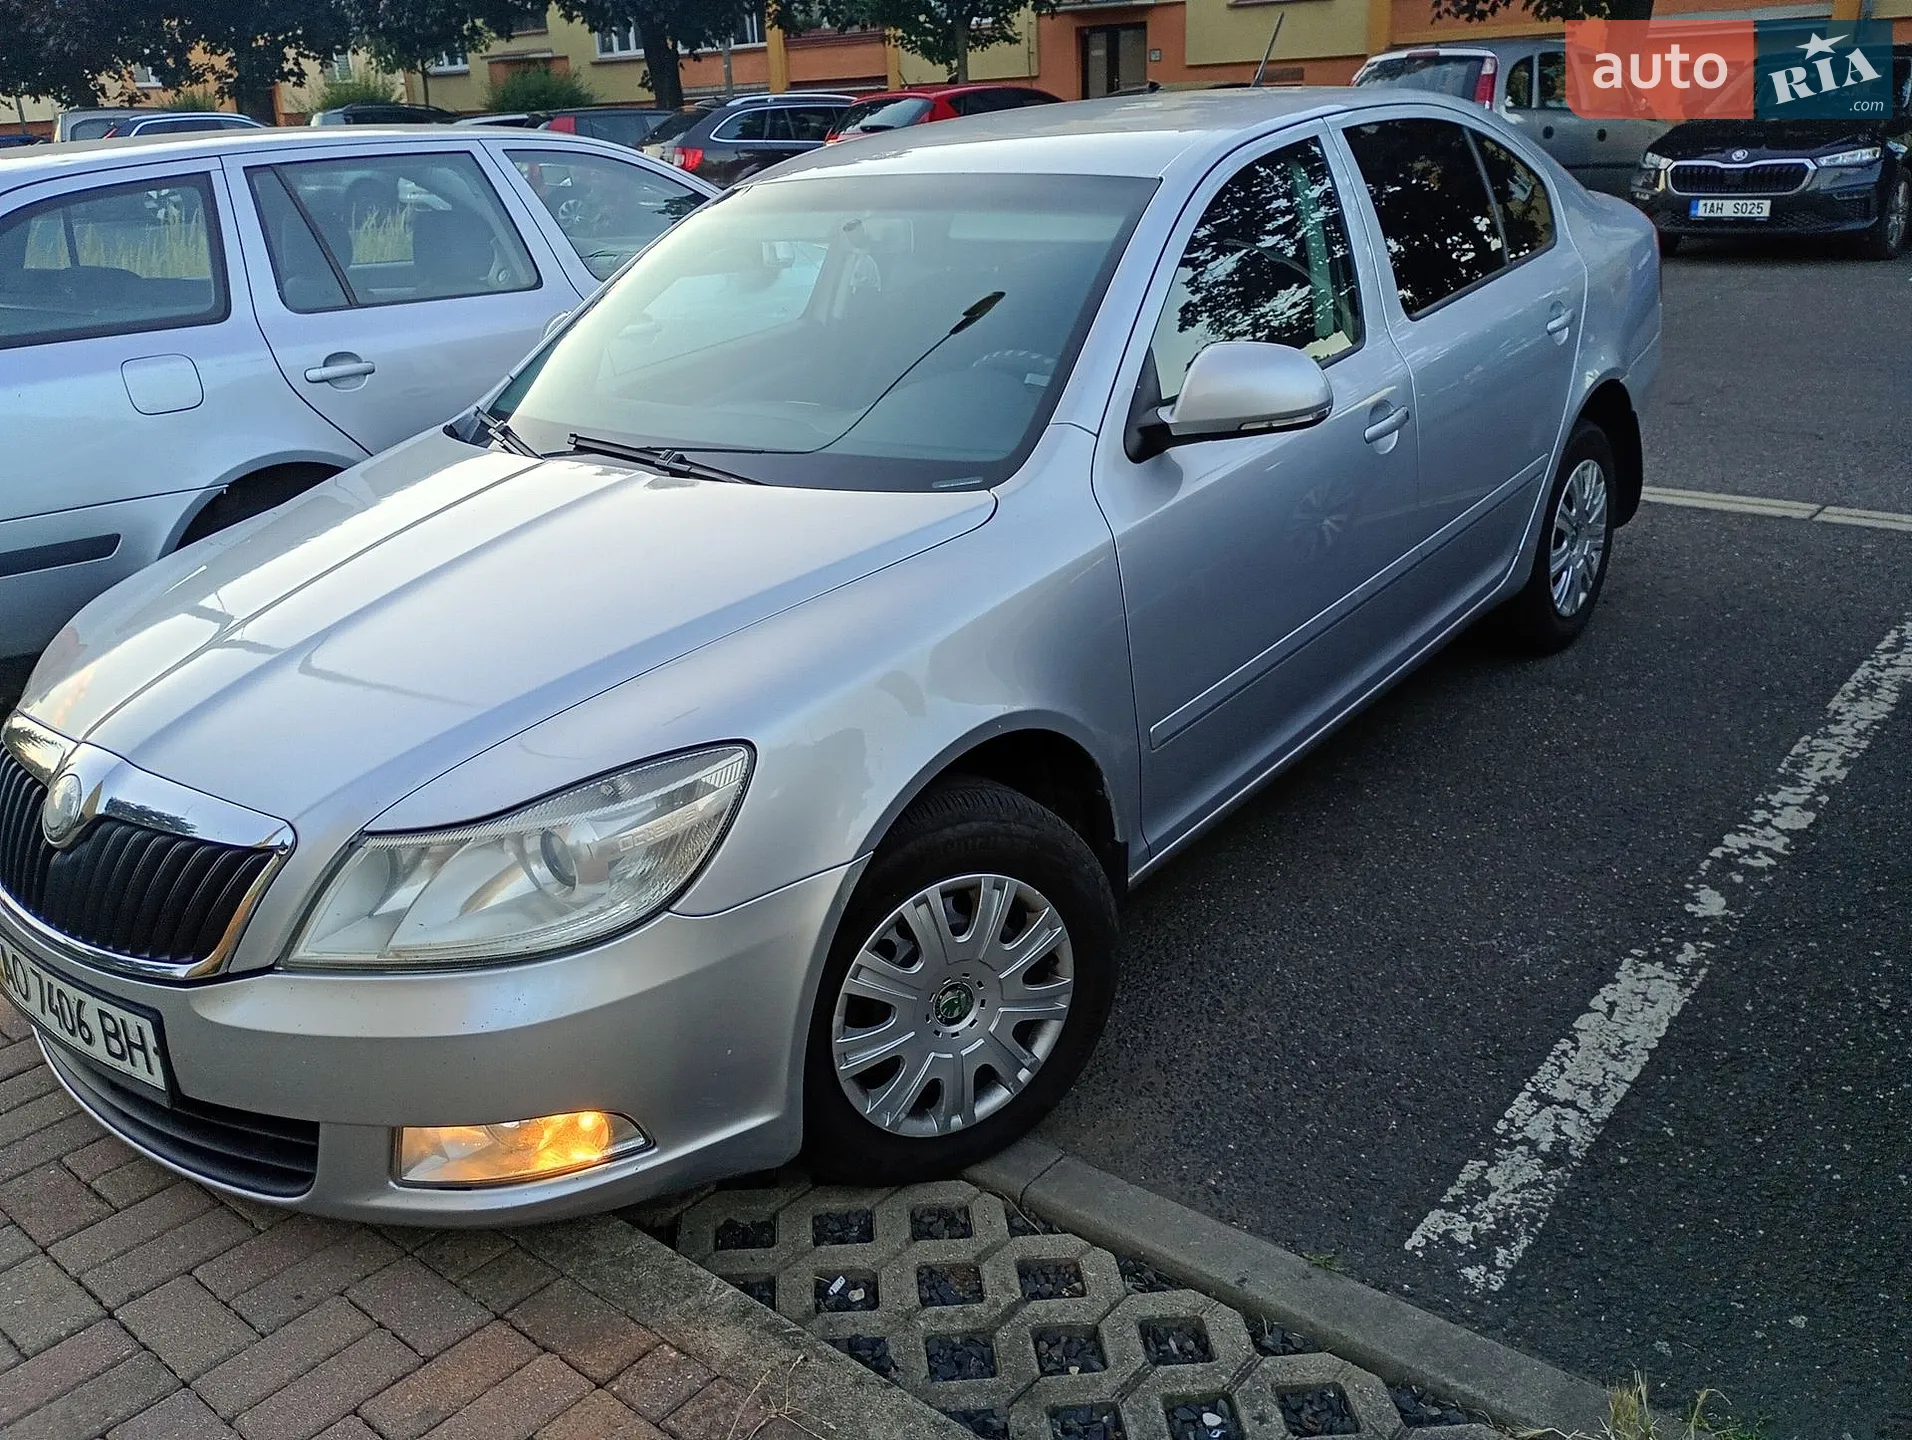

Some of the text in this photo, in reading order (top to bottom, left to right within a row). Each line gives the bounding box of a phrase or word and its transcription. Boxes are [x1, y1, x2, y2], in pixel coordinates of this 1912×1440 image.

[1702, 202, 1724, 214] 1AH
[29, 966, 96, 1047] 7406
[97, 1007, 155, 1077] BH
